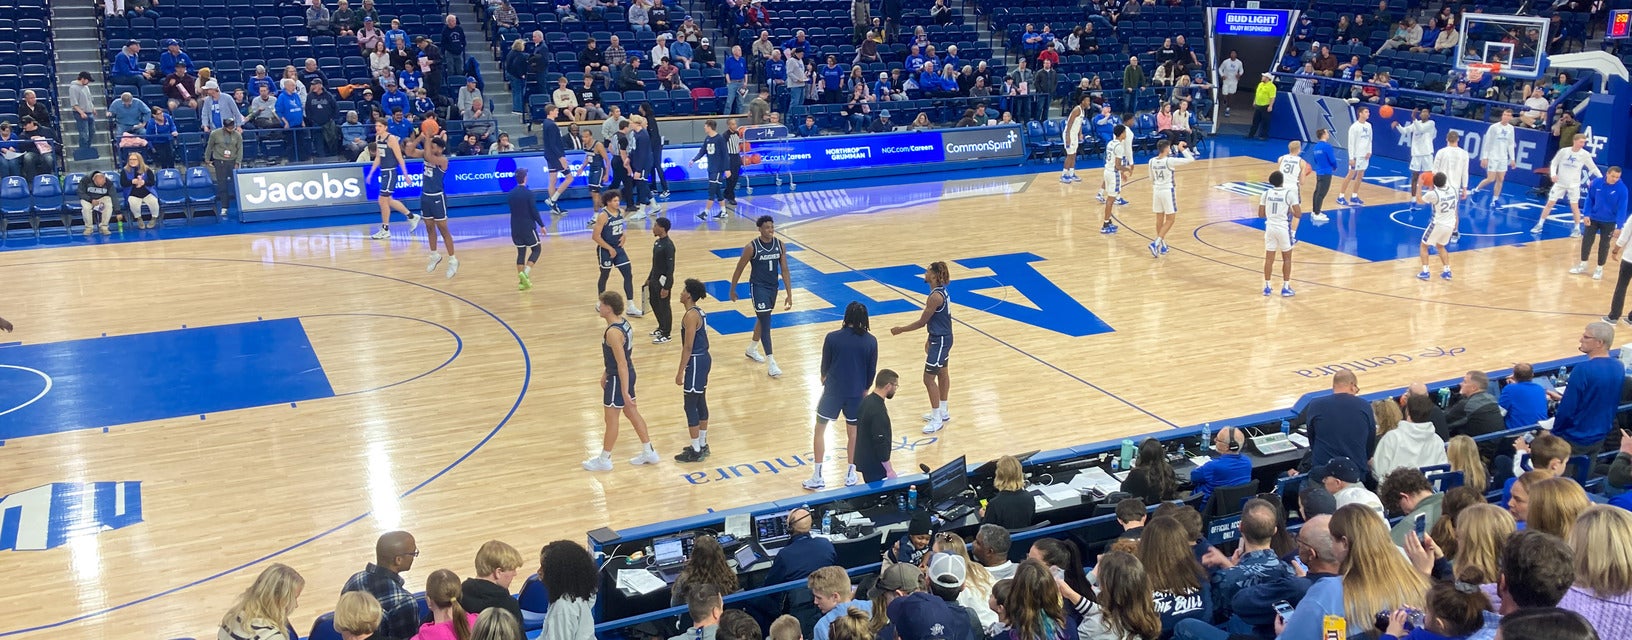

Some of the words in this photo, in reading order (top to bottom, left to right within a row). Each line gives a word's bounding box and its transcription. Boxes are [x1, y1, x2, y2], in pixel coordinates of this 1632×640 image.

[1228, 15, 1247, 23] BUD
[1248, 16, 1276, 24] LIGHT
[825, 147, 860, 155] NORTHROP
[881, 144, 934, 154] NGC.com/Careers
[946, 139, 1012, 153] CommonSpirit
[760, 153, 811, 161] GC.com/Careers
[455, 171, 515, 181] NGC.com/Care
[245, 172, 361, 205] Jacobs
[1440, 200, 1456, 213] 24
[769, 260, 773, 271] 1
[1295, 353, 1413, 379] centura
[1211, 523, 1230, 533] OFFICIAL
[1230, 520, 1242, 529] ACC
[1222, 530, 1235, 540] ONLY
[1152, 597, 1172, 613] THE
[1173, 595, 1204, 614] BULL
